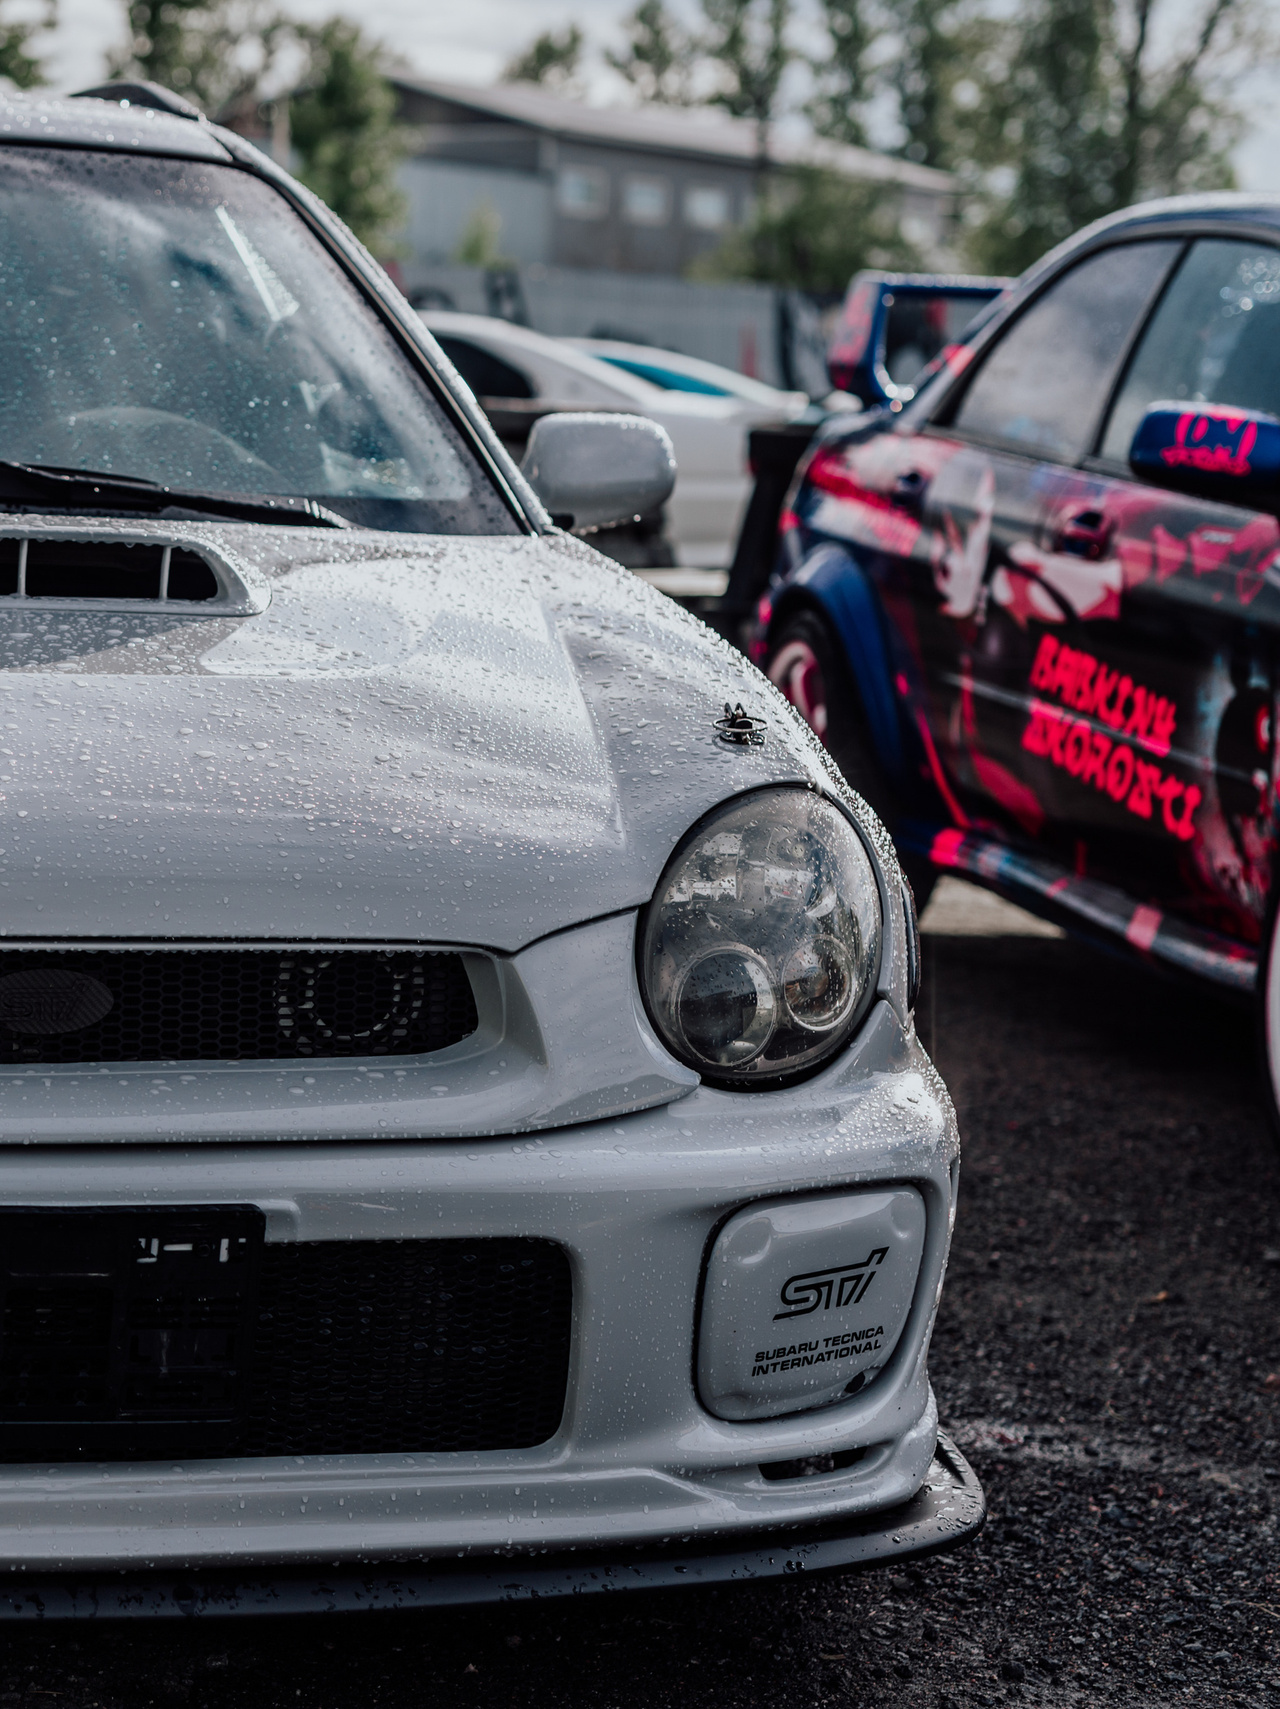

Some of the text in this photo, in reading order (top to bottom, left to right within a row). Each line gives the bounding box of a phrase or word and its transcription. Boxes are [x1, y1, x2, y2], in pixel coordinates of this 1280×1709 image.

[751, 1339, 882, 1377] INTERNATIONAL
[754, 1325, 884, 1363] SUBARU TECNICA
